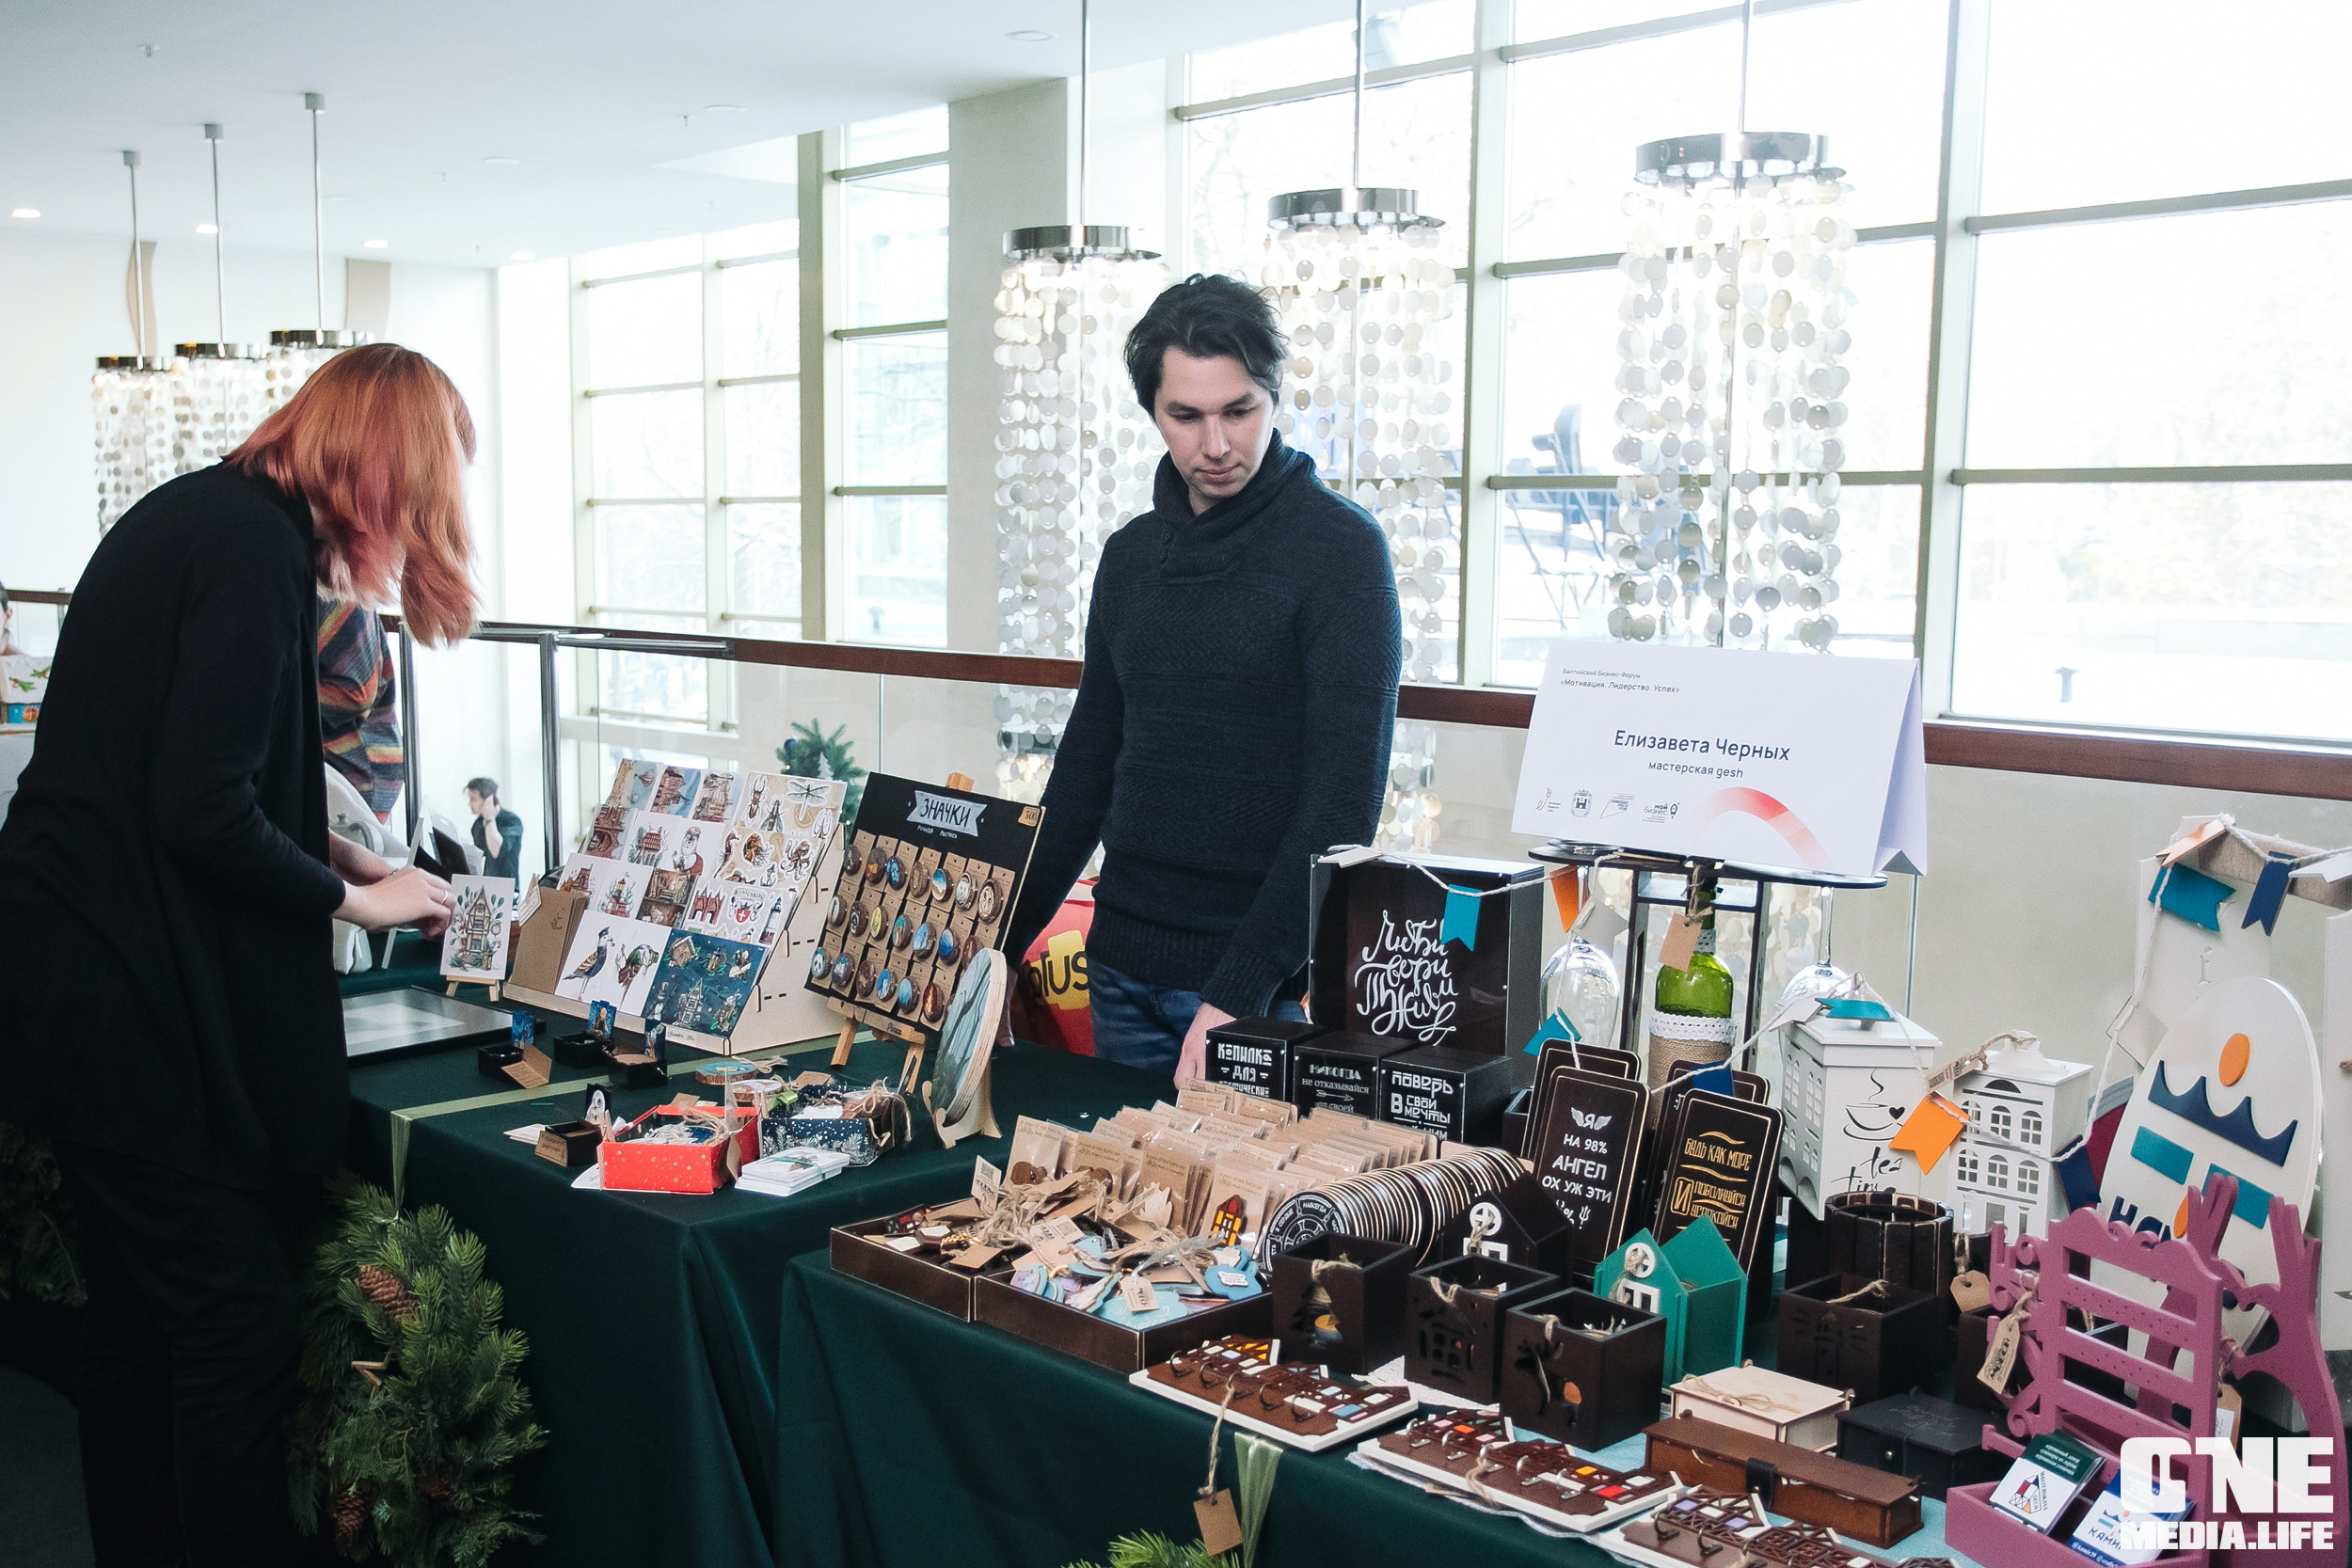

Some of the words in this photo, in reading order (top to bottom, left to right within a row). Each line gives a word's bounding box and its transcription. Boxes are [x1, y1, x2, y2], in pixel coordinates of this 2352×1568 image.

[1563, 668, 1597, 676] Балтийский
[1597, 671, 1641, 679] Бизнес-Форум
[1561, 678, 1607, 689] «Мотивация.
[1608, 681, 1652, 691] Лидерство.
[1653, 685, 1680, 693] Успех»
[1614, 729, 1709, 753] Елизавета
[1716, 737, 1791, 762] Черных
[1648, 761, 1714, 775] мастерская
[1716, 768, 1743, 779] gesh
[920, 798, 971, 828] ЗНАЧКИ
[1217, 1042, 1272, 1066] КОПИЛКА
[1232, 1065, 1256, 1082] ДЛЯ
[1310, 1064, 1361, 1080] НИКОГДА
[1302, 1078, 1313, 1086] не
[1314, 1080, 1370, 1094] отказывайся
[1391, 1070, 1454, 1099] ПОВЕРЬ
[1391, 1093, 1403, 1114] В
[1406, 1095, 1437, 1110] СВОИ
[1405, 1106, 1451, 1124] МЕЧТЫ
[1563, 1133, 1580, 1148] НА
[1584, 1138, 1608, 1154] 98%
[1684, 1137, 1707, 1159] БУДЬ
[1708, 1145, 1725, 1165] КАК
[1726, 1150, 1752, 1171] МОРЕ
[1552, 1154, 1607, 1180] АНГЕЛ
[1860, 1147, 1902, 1179] tea
[1542, 1176, 1561, 1191] ОХ
[1564, 1180, 1582, 1196] УЖ
[1585, 1185, 1613, 1204] ЭТИ
[2088, 1526, 2121, 1551] КАМИ
